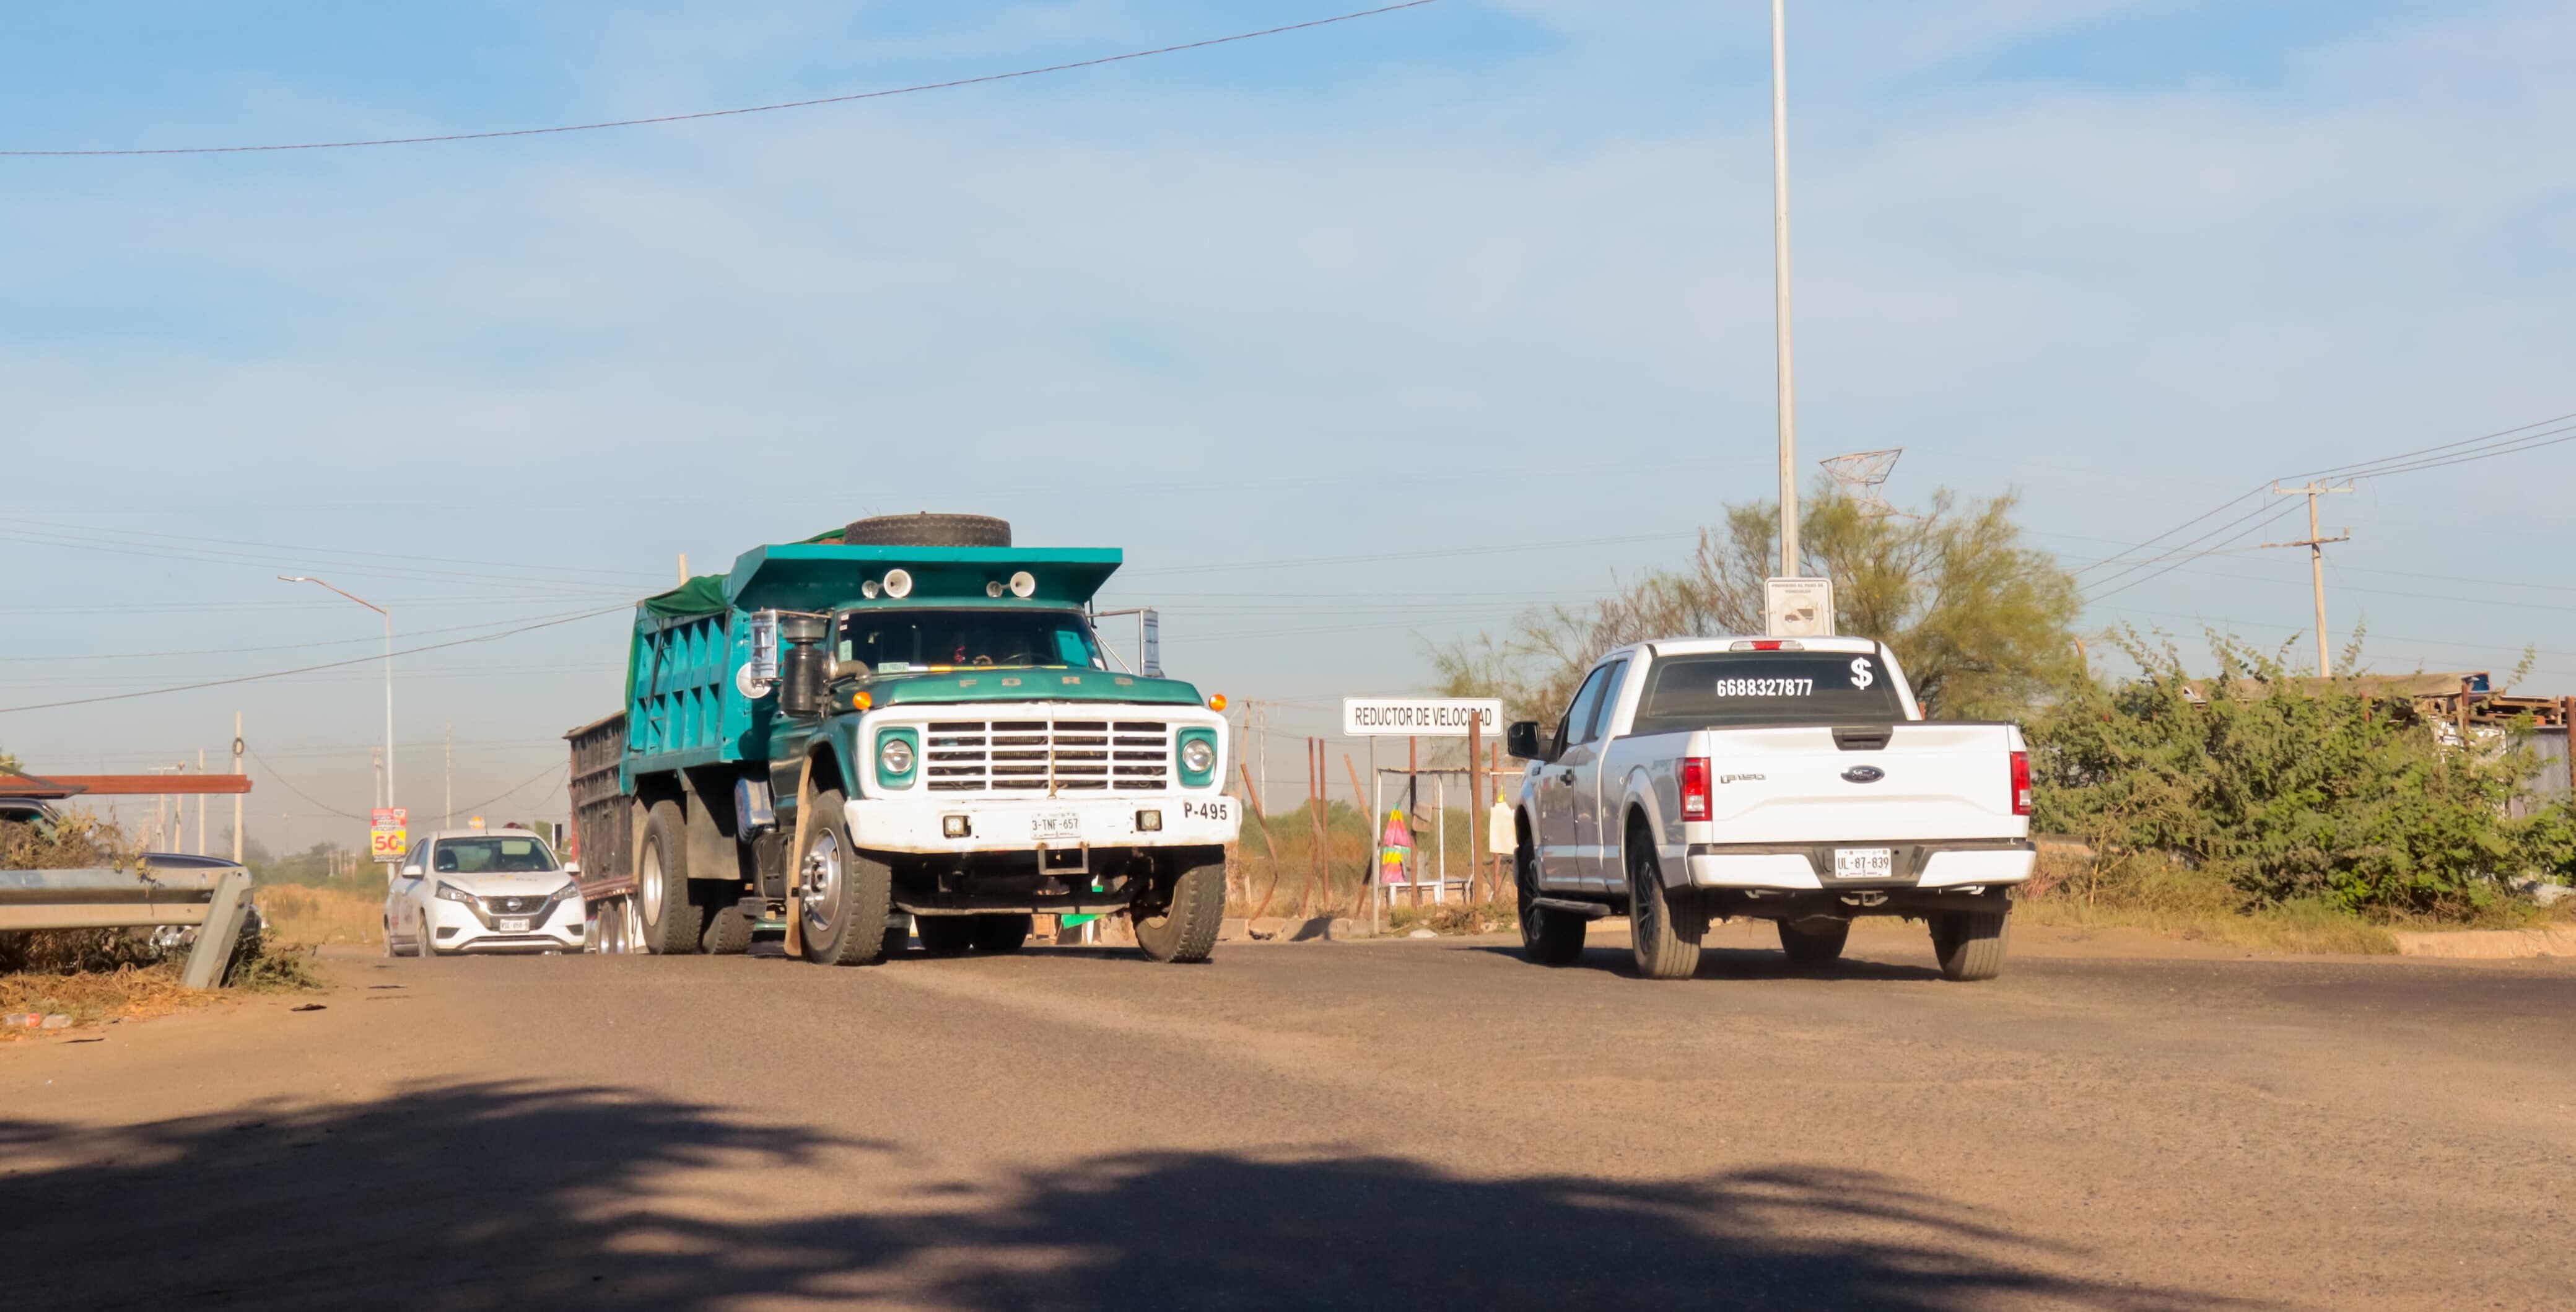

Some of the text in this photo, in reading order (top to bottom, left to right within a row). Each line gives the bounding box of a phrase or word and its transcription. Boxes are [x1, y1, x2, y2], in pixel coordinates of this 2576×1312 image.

[959, 676, 1133, 688] FORD
[1851, 657, 1873, 689] $
[1717, 678, 1813, 697] 6688327877
[1355, 707, 1492, 726] REDUCTOR DE VELOCIAD
[1184, 802, 1227, 820] P-495
[1032, 818, 1078, 831] 3-TNF-657
[1838, 857, 1888, 870] UL-87-839
